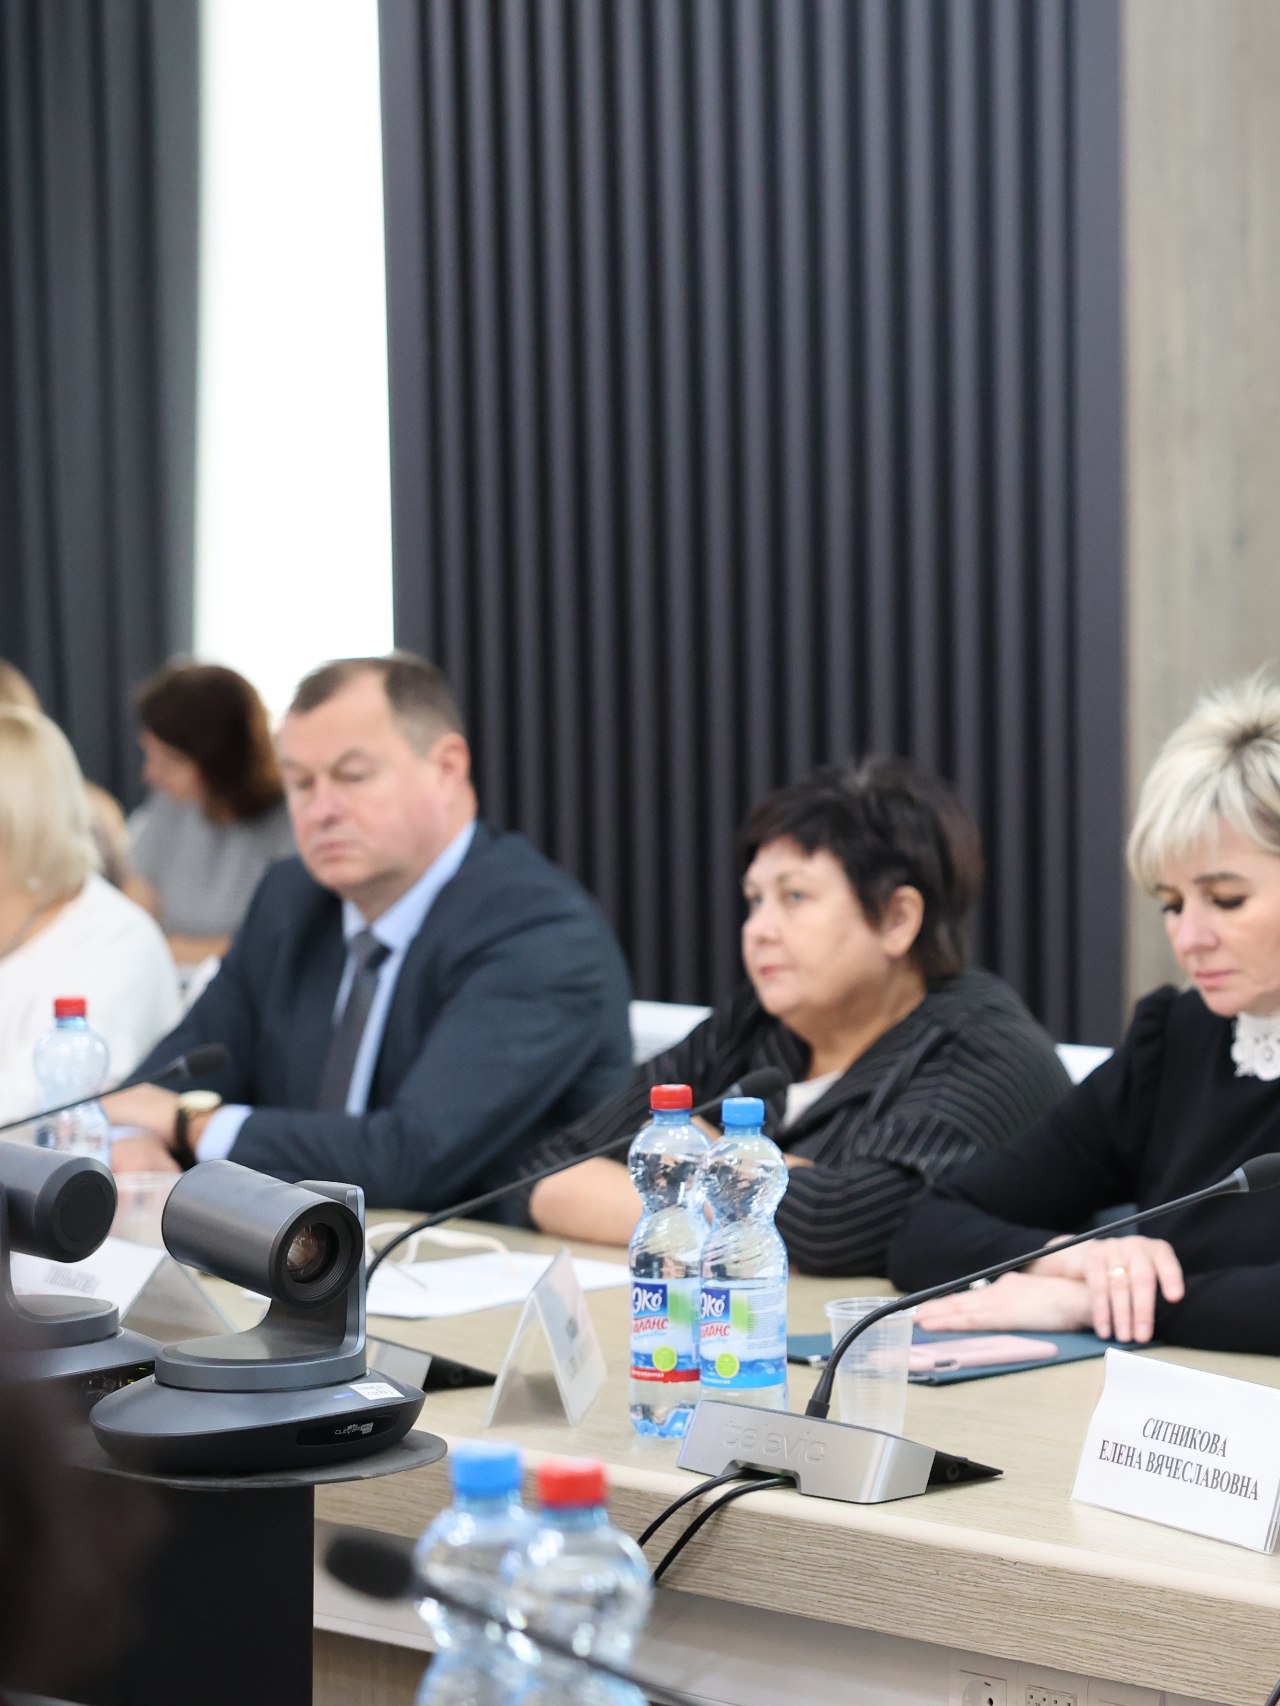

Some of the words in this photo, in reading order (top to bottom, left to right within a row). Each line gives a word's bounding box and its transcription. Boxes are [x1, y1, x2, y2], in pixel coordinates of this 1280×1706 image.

[1142, 1417, 1228, 1457] СИТНИКОВА
[1099, 1439, 1142, 1470] ЕЛЕНА
[1145, 1451, 1258, 1500] ВЯЧЕСЛАВОВНА
